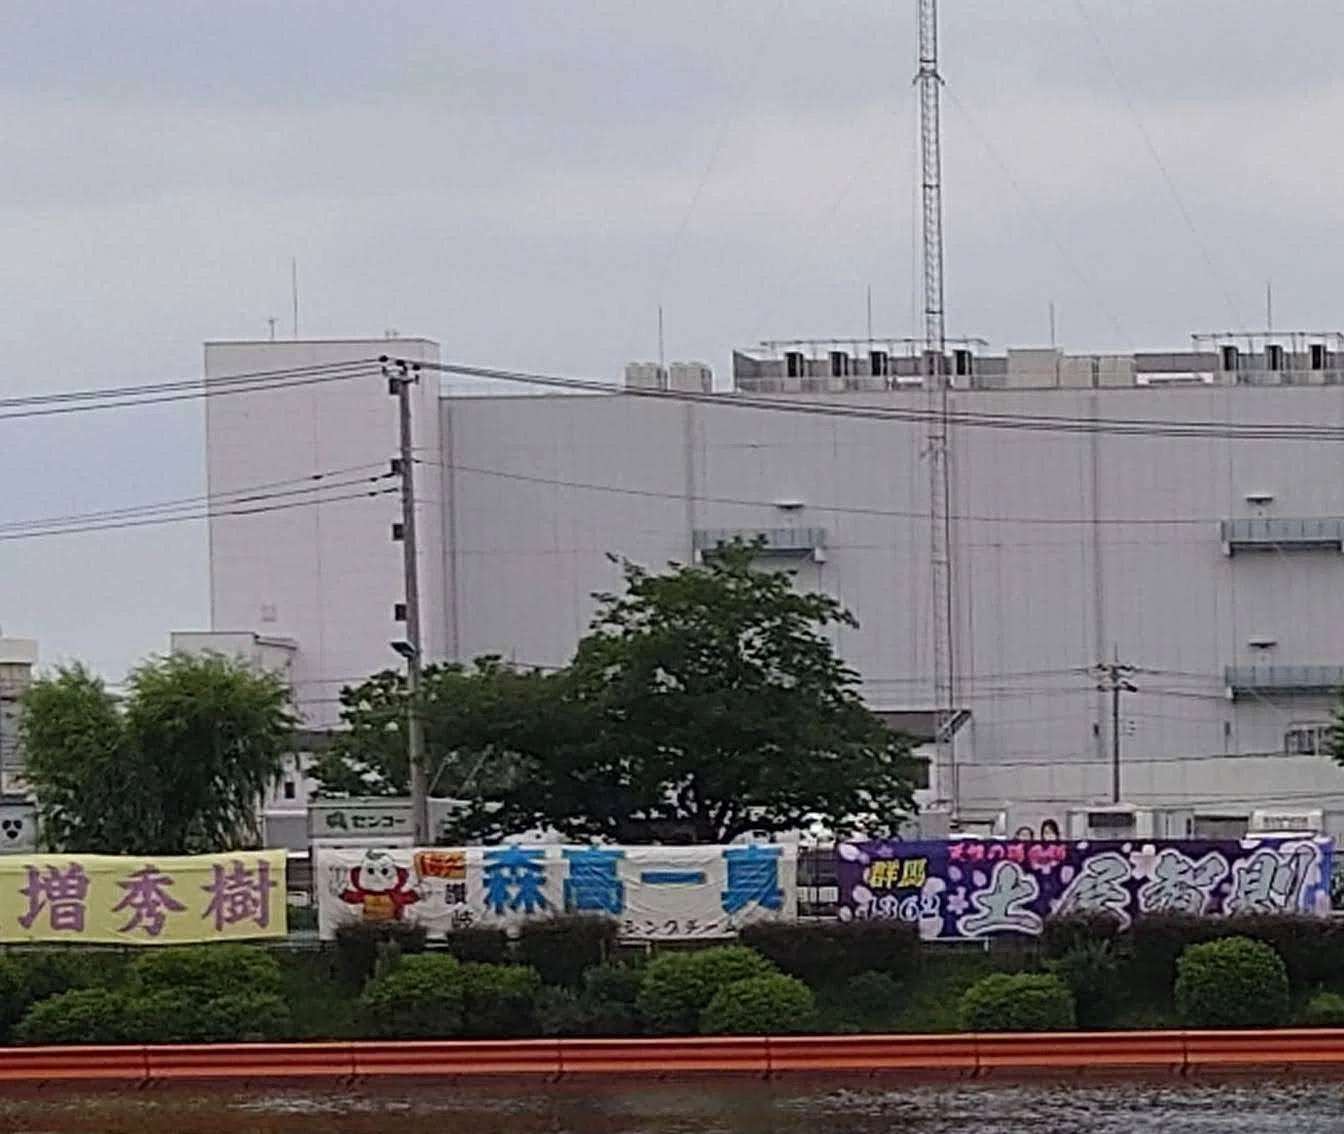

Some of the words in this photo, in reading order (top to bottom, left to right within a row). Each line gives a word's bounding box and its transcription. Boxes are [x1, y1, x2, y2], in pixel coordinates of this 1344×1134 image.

[351, 815, 406, 828] センコー
[870, 858, 928, 888] 群馬
[18, 859, 278, 937] 増秀樹
